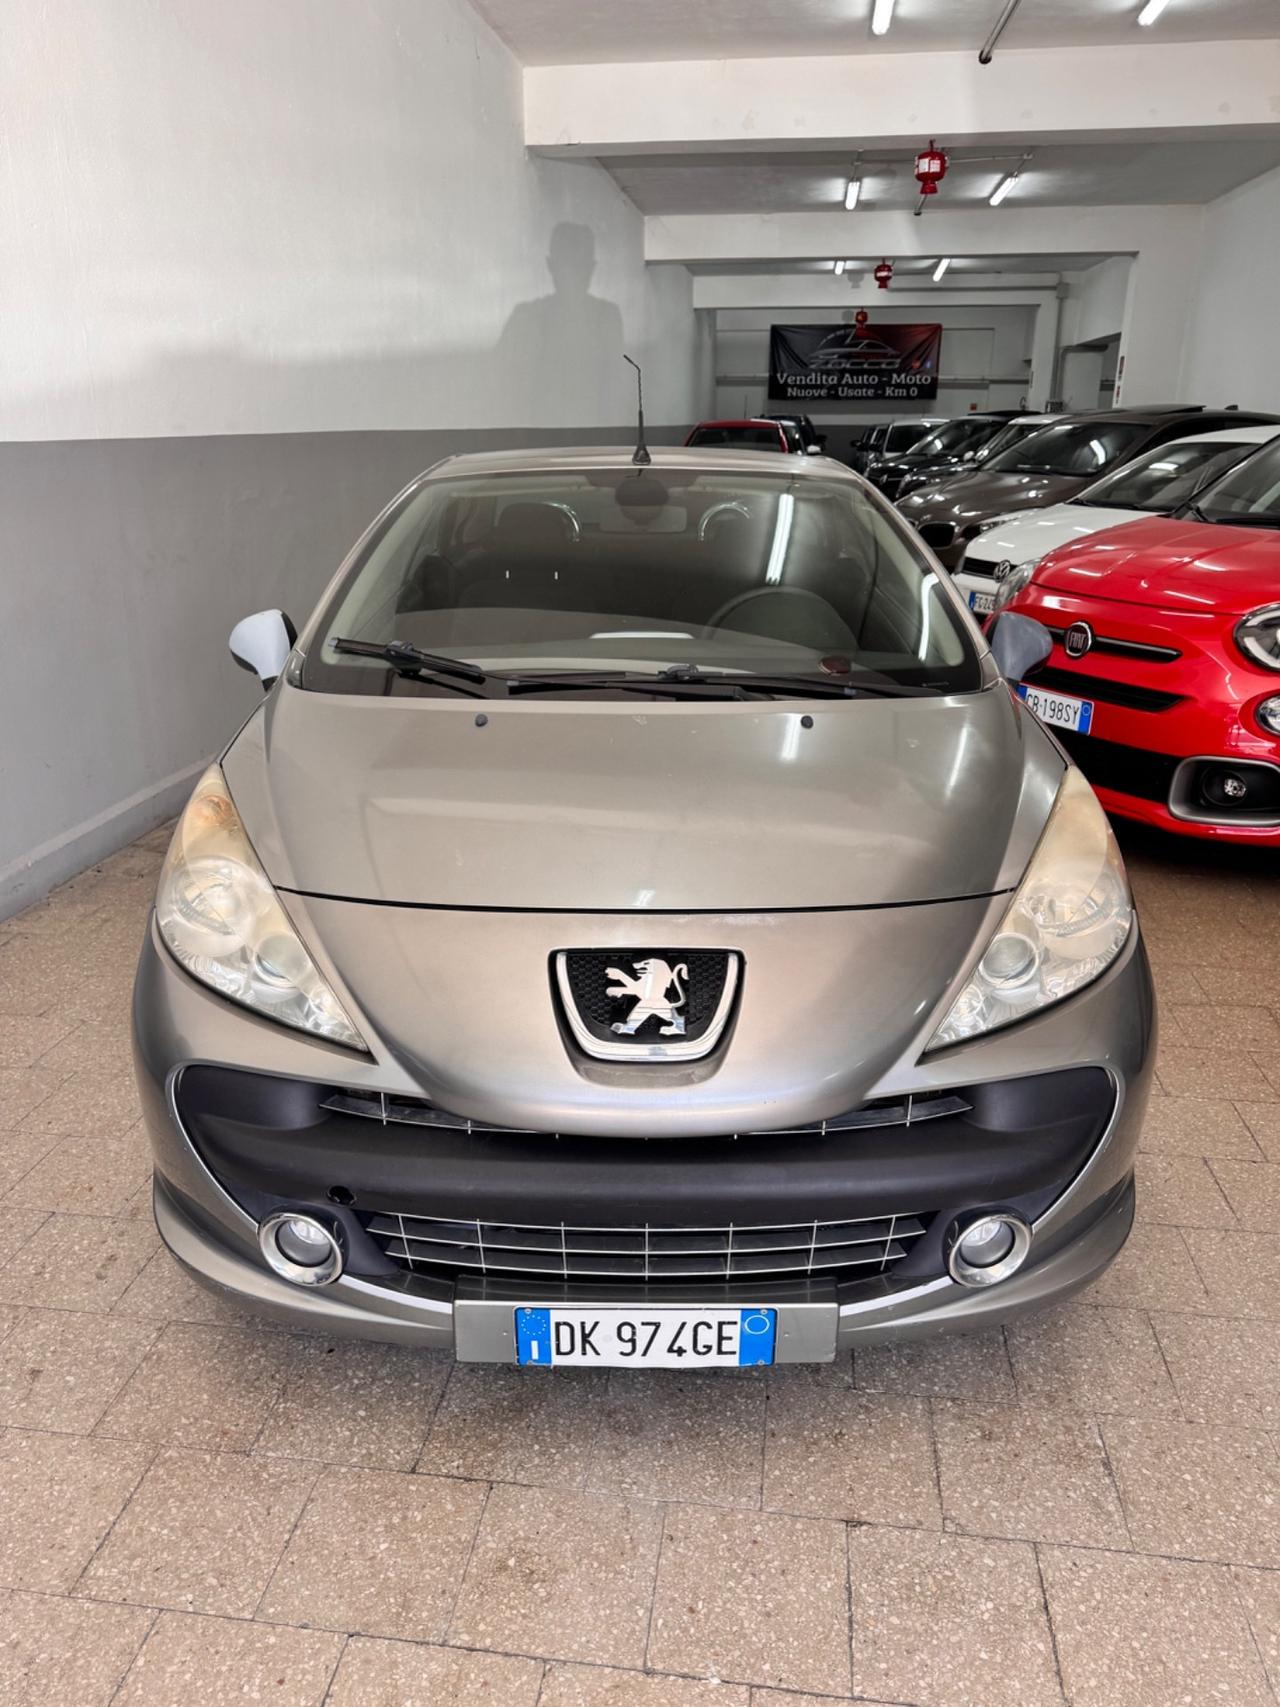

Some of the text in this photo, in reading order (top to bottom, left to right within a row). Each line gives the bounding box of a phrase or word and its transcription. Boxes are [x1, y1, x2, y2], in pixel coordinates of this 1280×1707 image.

[776, 373, 838, 385] Vendita
[841, 373, 879, 385] Auto
[891, 373, 931, 385] Moto
[787, 387, 827, 397] Nuove
[838, 387, 875, 397] Usate
[885, 387, 907, 397] Km
[1069, 631, 1087, 649] FIAT
[1042, 698, 1080, 725] 198SY
[554, 1320, 601, 1356] DK
[616, 1320, 738, 1357] 974GE
